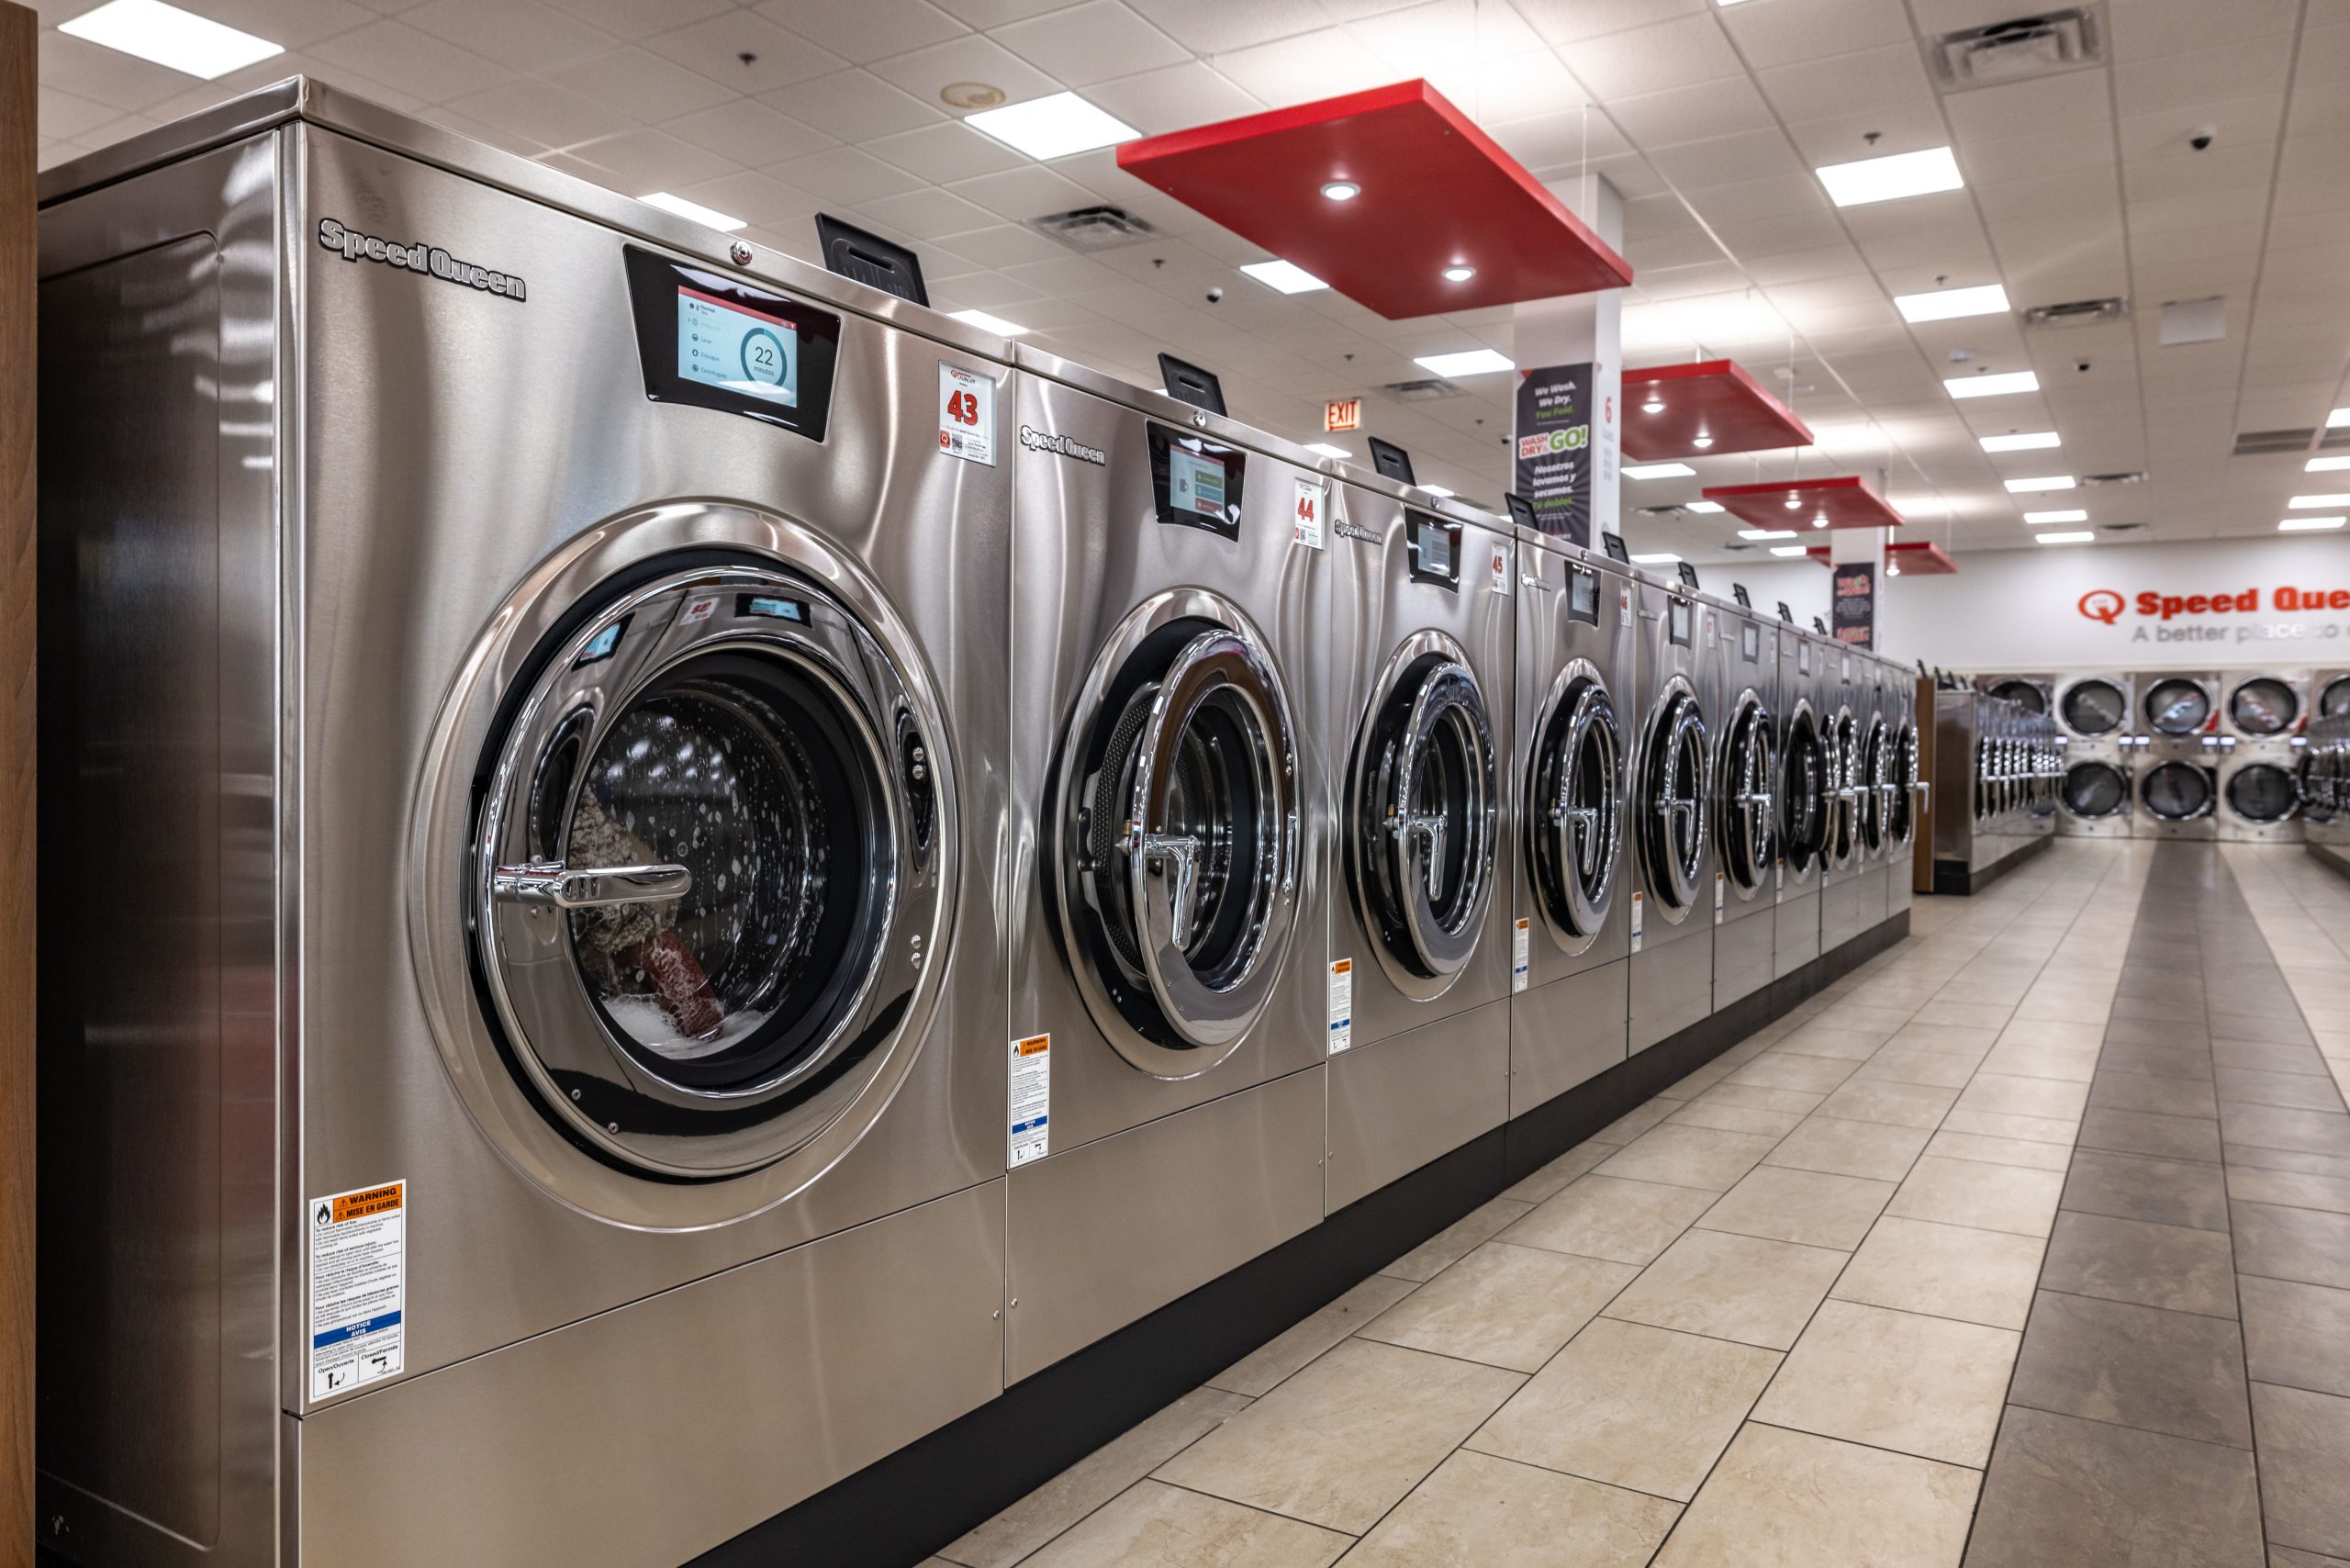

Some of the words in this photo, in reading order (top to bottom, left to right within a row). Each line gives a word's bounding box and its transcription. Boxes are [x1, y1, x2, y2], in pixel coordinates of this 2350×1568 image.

[320, 218, 429, 274] Speed
[429, 248, 526, 302] Queen
[755, 346, 773, 366] 22
[753, 366, 774, 376] minutos
[1535, 387, 1549, 397] We
[1550, 381, 1577, 393] Wash.
[947, 390, 978, 426] 43
[1539, 398, 1553, 407] We
[1554, 395, 1572, 405] Dry.
[1329, 401, 1357, 424] EXIT
[1606, 396, 1612, 424] 6
[1021, 425, 1065, 455] Speed
[1065, 437, 1105, 465] Queen
[1521, 436, 1548, 446] WASH
[1550, 426, 1587, 451] GO!
[1521, 445, 1542, 456] DRY
[1534, 462, 1574, 475] Nosotros
[1533, 474, 1569, 487] lavamos
[1570, 473, 1577, 483] y
[1534, 486, 1574, 498] secamos.
[1298, 497, 1314, 522] 44
[1493, 555, 1502, 574] 45
[2135, 588, 2259, 620] Speed
[2132, 627, 2149, 642] A
[2157, 625, 2228, 641] better
[2236, 623, 2306, 644] place
[349, 1187, 397, 1204] WARNING
[347, 1207, 364, 1218] MISE
[366, 1204, 375, 1213] EN
[377, 1198, 398, 1210] GARDE
[346, 1320, 371, 1332] NOTICE
[351, 1328, 366, 1337] AVIS
[361, 1344, 398, 1360] Closed/Fermée
[318, 1359, 355, 1374] Open/Ouverte
